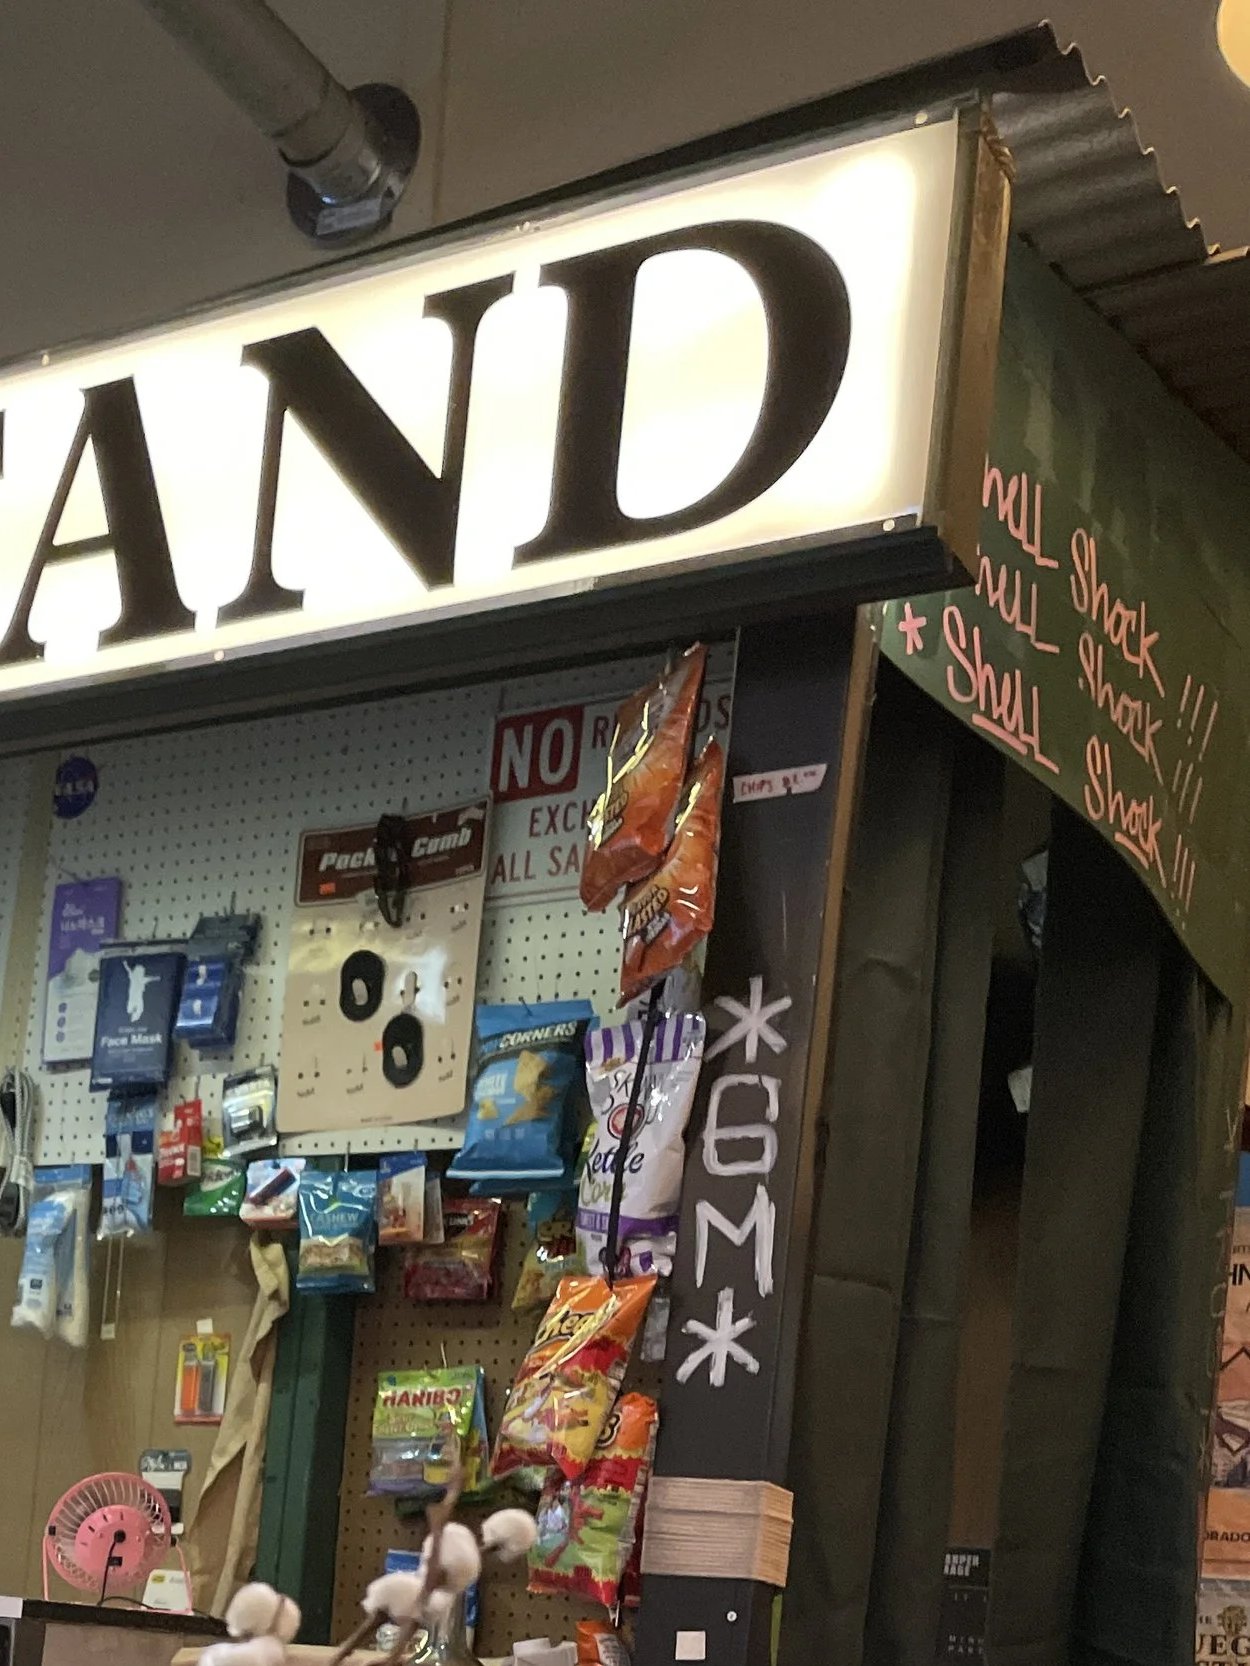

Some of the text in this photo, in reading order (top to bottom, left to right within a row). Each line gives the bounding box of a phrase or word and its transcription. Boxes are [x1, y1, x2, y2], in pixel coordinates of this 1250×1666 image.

[1070, 528, 1165, 698] Shock
[1078, 632, 1164, 787] Shock
[499, 717, 574, 795] NO
[1084, 735, 1167, 889] Shock
[411, 827, 472, 859] Comb
[491, 850, 536, 886] ALL
[101, 1033, 162, 1048] Face Mask
[498, 1021, 578, 1050] CORNERS
[586, 1138, 646, 1183] Kette
[579, 1173, 627, 1207] Cor
[382, 1387, 463, 1408] HARIBO
